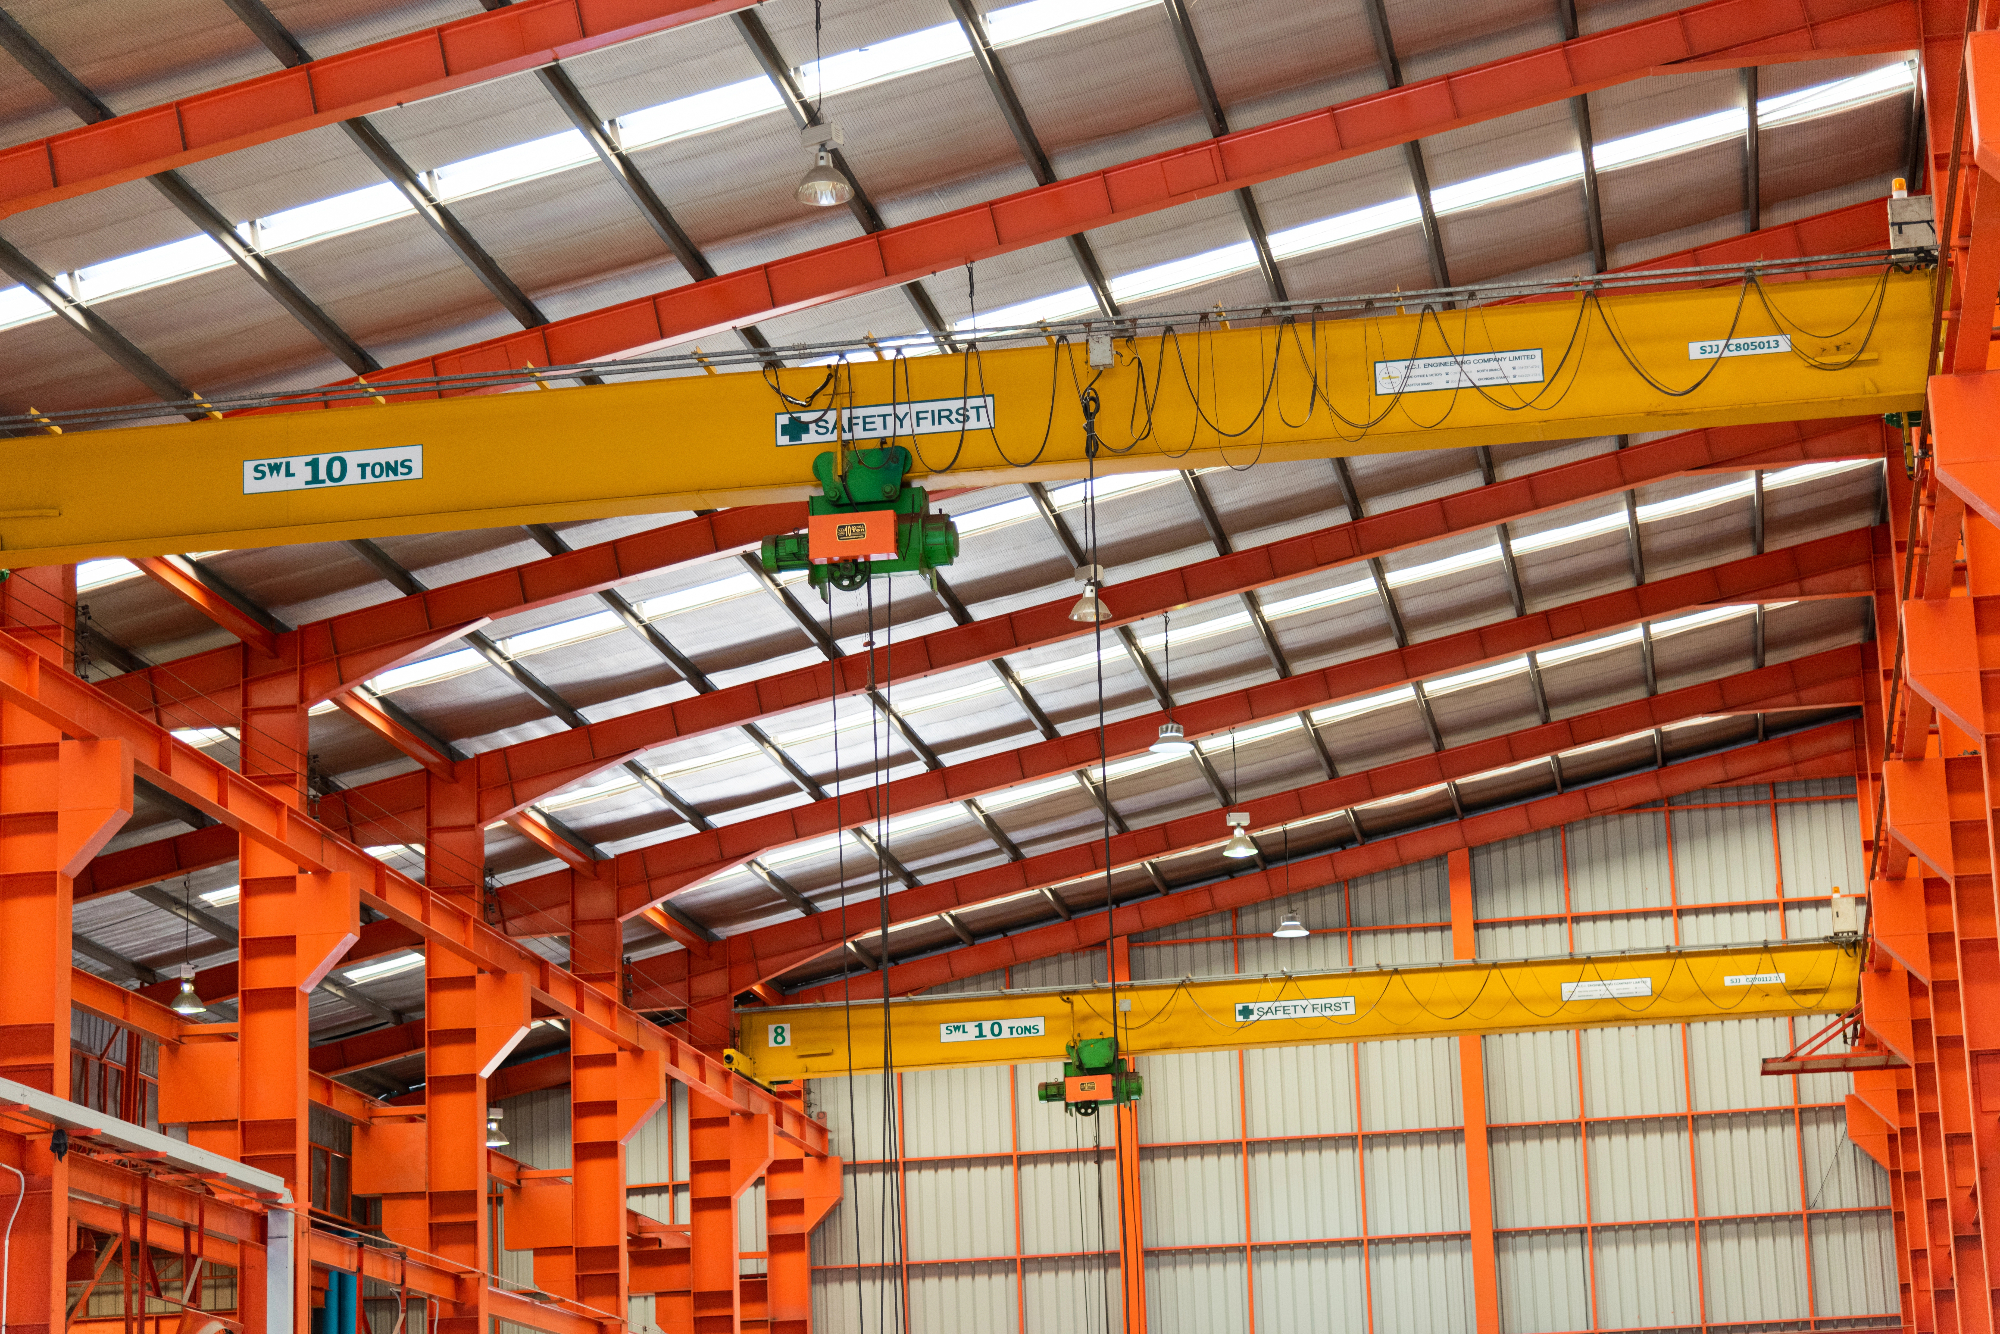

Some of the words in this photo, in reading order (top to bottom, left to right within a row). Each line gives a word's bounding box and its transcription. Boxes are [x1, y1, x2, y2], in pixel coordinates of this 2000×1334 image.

[1699, 344, 1719, 355] SJJ
[1726, 339, 1780, 352] C805013
[1423, 359, 1471, 369] ENGINEERING
[1473, 356, 1507, 365] COMPANY
[1508, 354, 1536, 362] LIMITED
[814, 411, 909, 436] SAFETY
[915, 405, 986, 427] FIRST
[253, 461, 296, 481] SWL
[304, 455, 348, 486] 10
[357, 458, 413, 480] TONS
[1256, 1004, 1309, 1017] SAFETY
[1311, 1001, 1351, 1013] FIRST
[773, 1025, 786, 1045] 8
[945, 1024, 968, 1035] SWL
[974, 1021, 1003, 1039] 10
[1007, 1024, 1040, 1036] TONS
